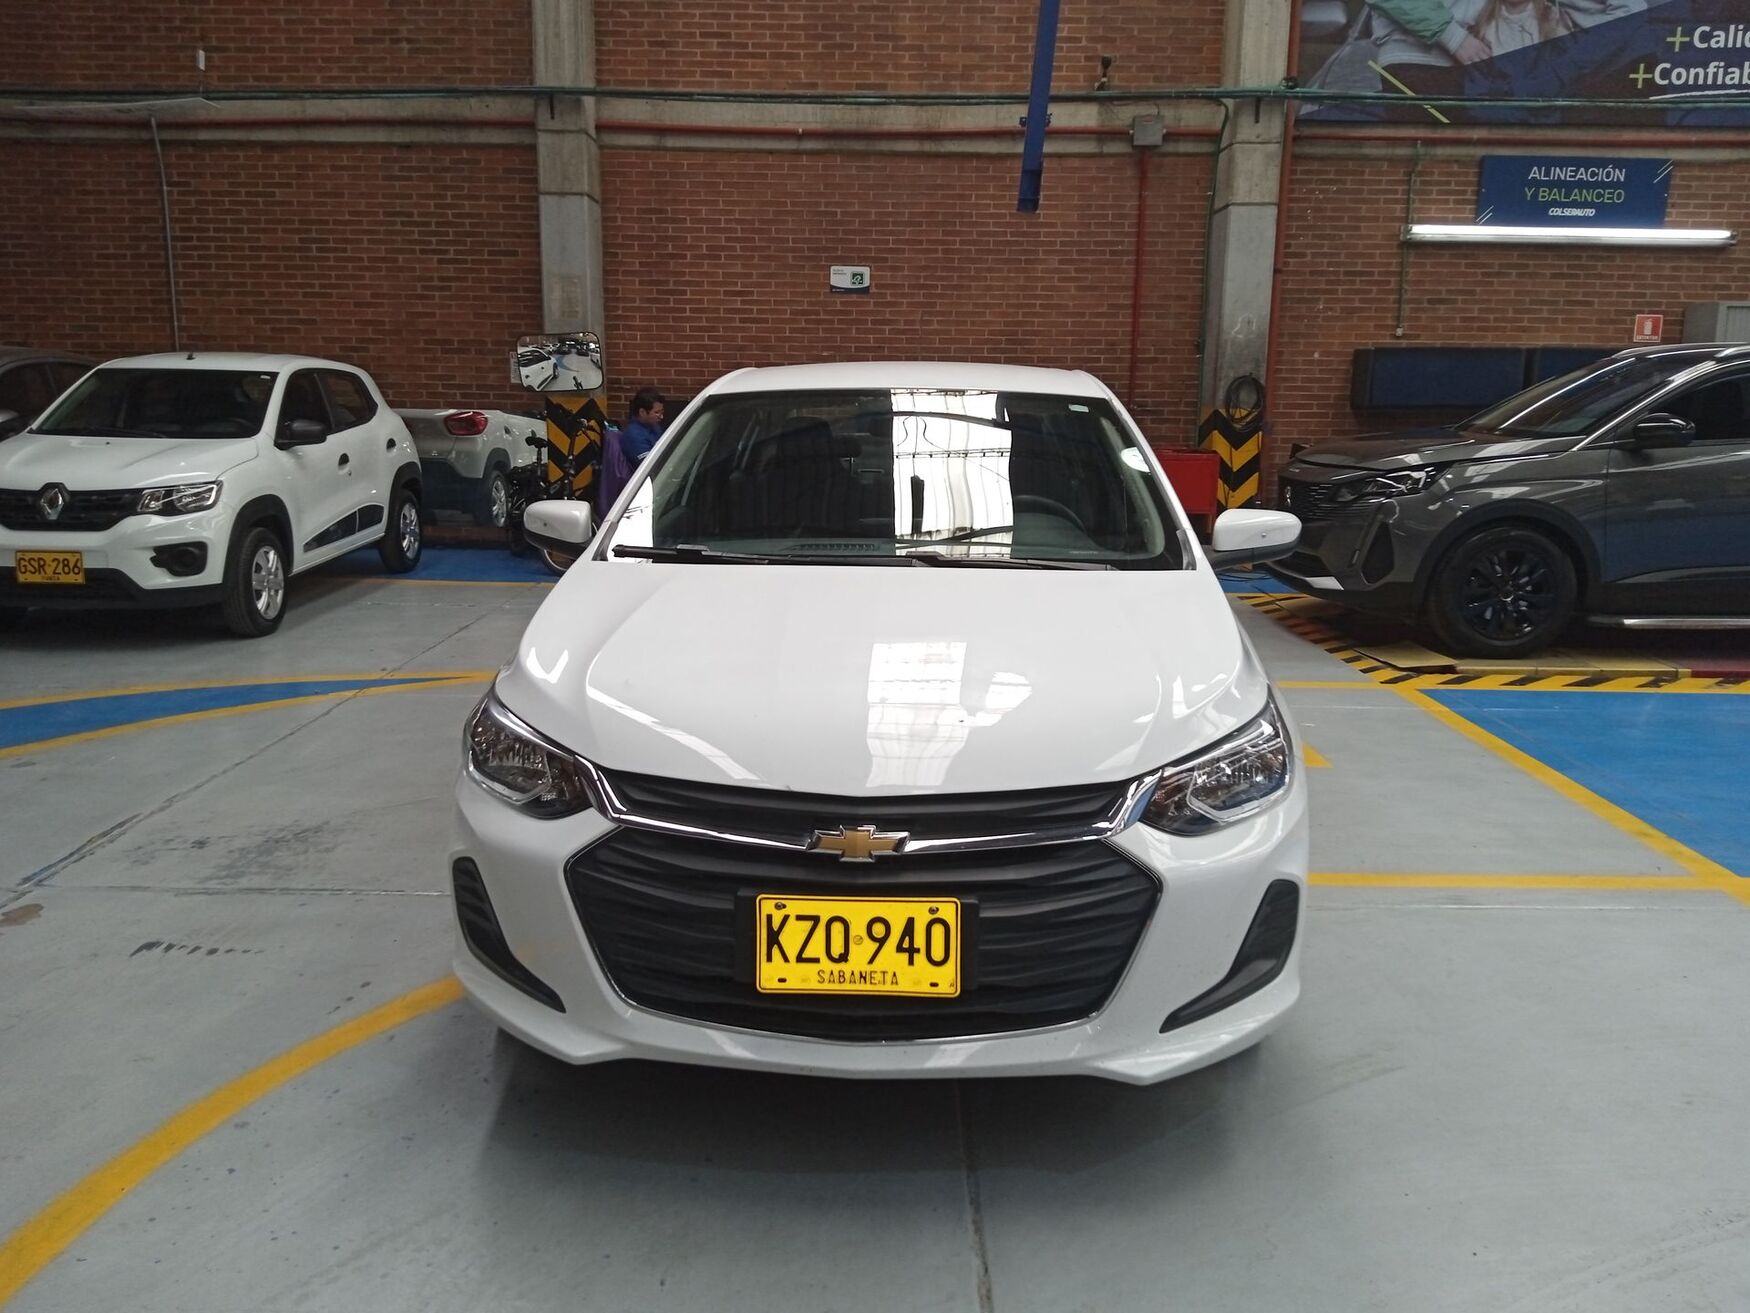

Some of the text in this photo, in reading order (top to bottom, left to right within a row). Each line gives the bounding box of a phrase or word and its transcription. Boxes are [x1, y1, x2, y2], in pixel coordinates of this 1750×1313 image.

[1528, 164, 1626, 182] ALINEACIÓN
[1524, 187, 1625, 203] Y BALANCEO
[18, 557, 81, 575] GSR 286
[765, 913, 951, 967] KZQ 940
[817, 969, 900, 986] SABANETA
